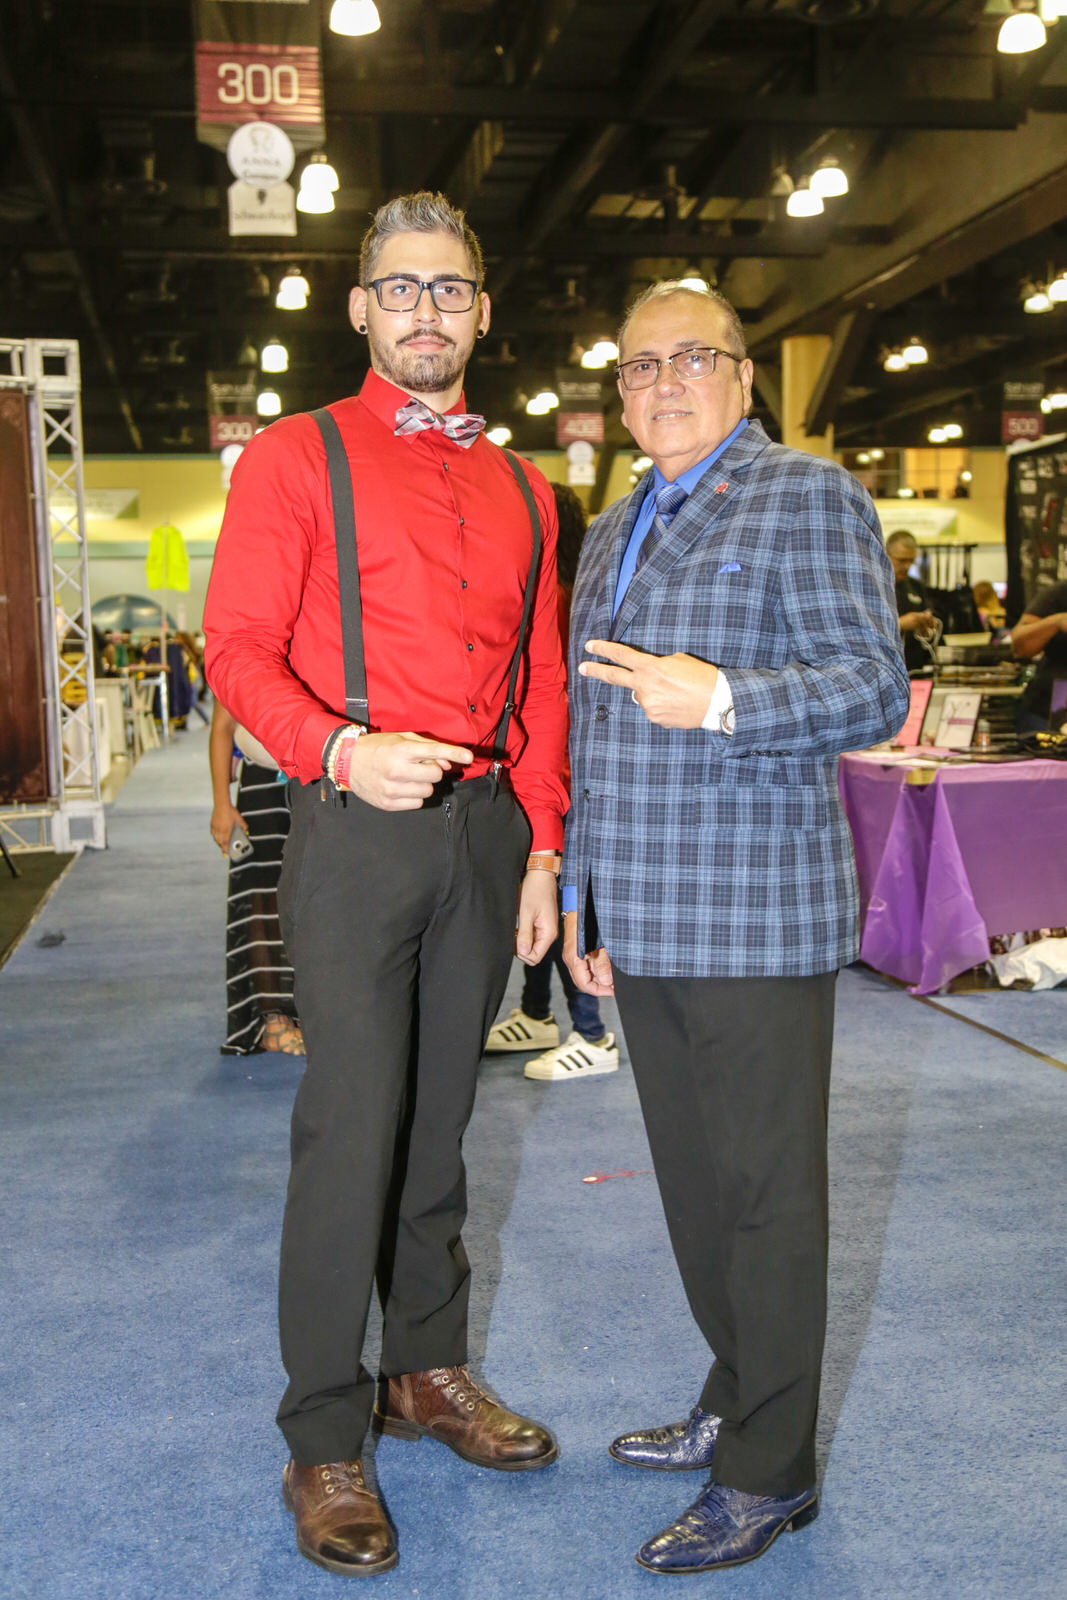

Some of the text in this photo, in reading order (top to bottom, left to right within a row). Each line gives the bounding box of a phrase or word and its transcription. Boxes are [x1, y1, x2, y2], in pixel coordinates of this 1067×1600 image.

[218, 62, 299, 106] 300
[217, 421, 252, 441] 300
[564, 419, 598, 437] 400
